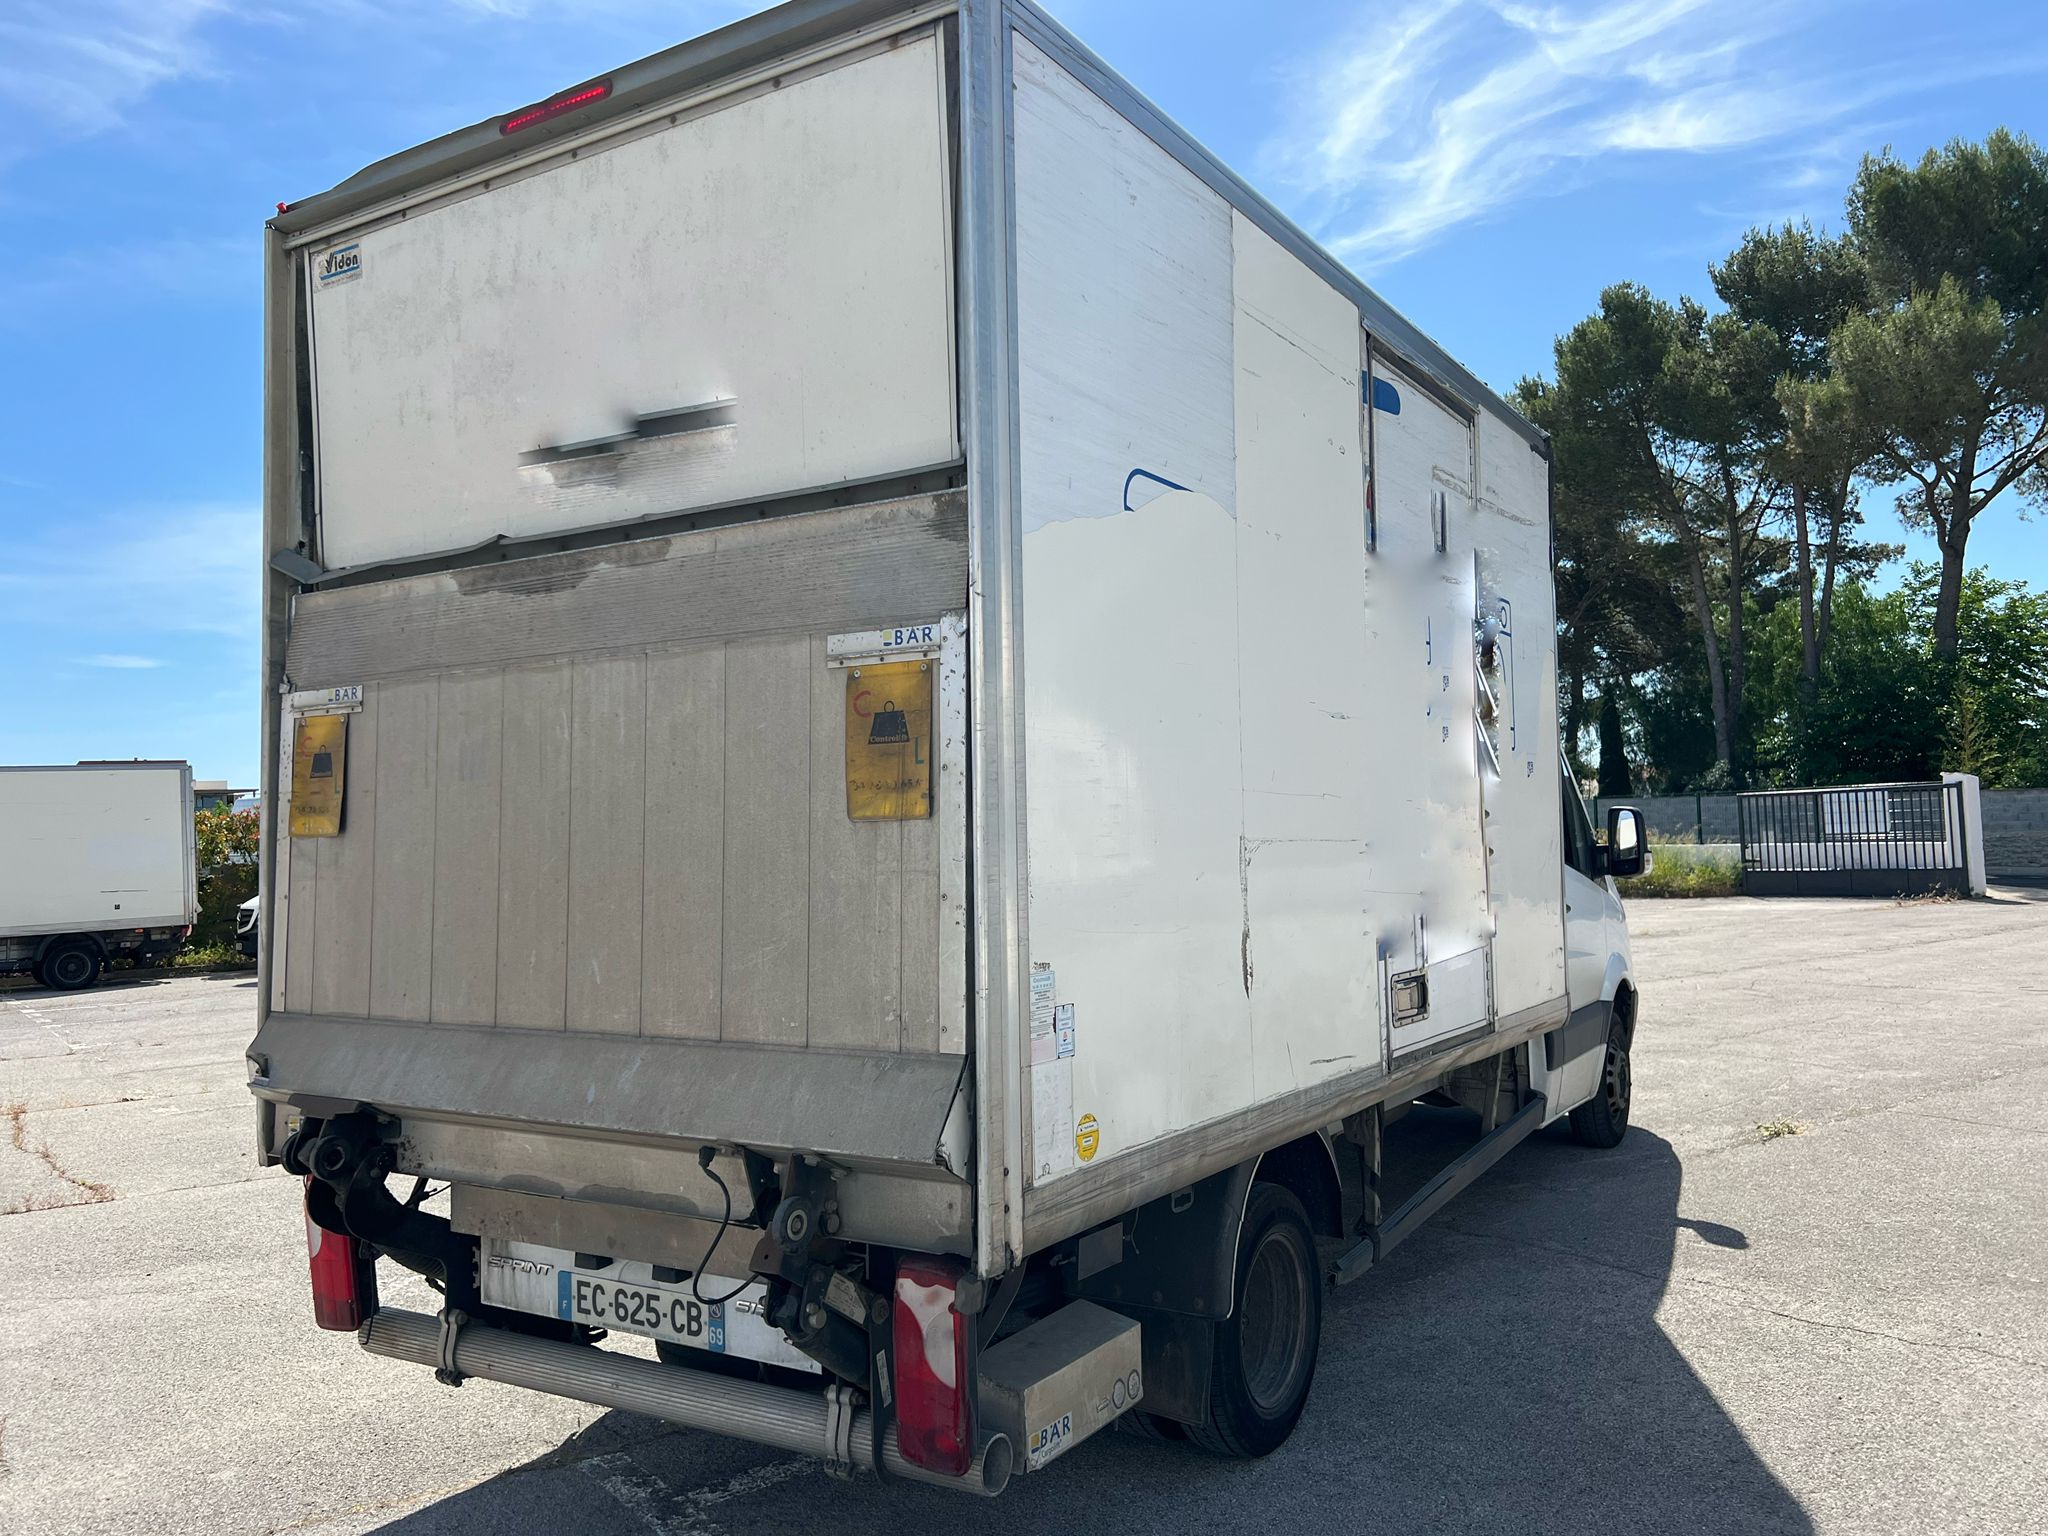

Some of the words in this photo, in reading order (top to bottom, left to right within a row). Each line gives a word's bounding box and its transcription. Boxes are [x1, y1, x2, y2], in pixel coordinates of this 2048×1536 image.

[325, 251, 358, 273] Vidon
[488, 1255, 554, 1276] SPRINT
[562, 1300, 568, 1310] F
[576, 1280, 703, 1337] EC-625-CB
[709, 1327, 724, 1346] 69
[1040, 1415, 1071, 1449] BÄR
